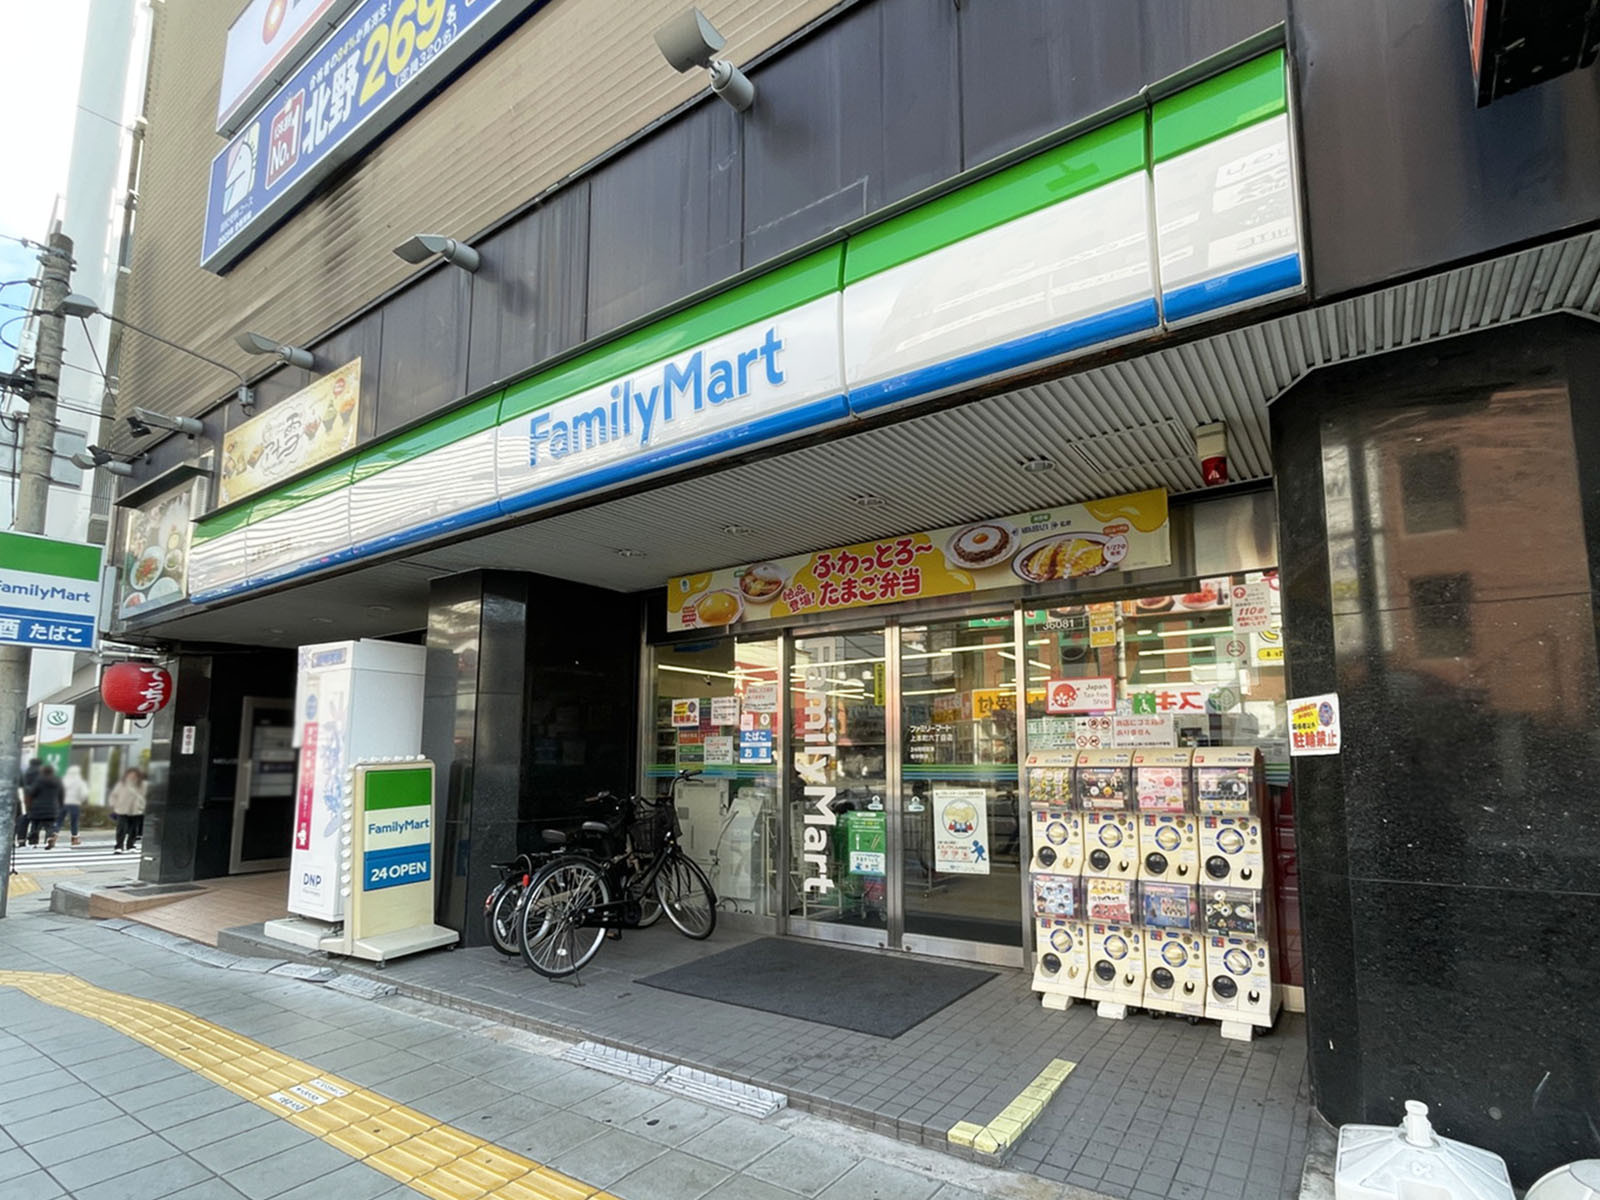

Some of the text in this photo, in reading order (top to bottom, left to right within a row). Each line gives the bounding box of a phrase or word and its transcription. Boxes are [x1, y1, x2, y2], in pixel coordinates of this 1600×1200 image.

[270, 103, 301, 176] No.1
[530, 327, 785, 467] FamilyMart
[819, 568, 921, 606] たまご弁当
[29, 623, 82, 643] たばこ
[745, 732, 767, 742] たばこ
[910, 725, 952, 733] ファミリーマート
[1292, 730, 1337, 748] 駐輪禁止
[795, 637, 837, 893] FamilyMart
[368, 819, 430, 835] FamilyMart
[303, 872, 322, 888] DNP
